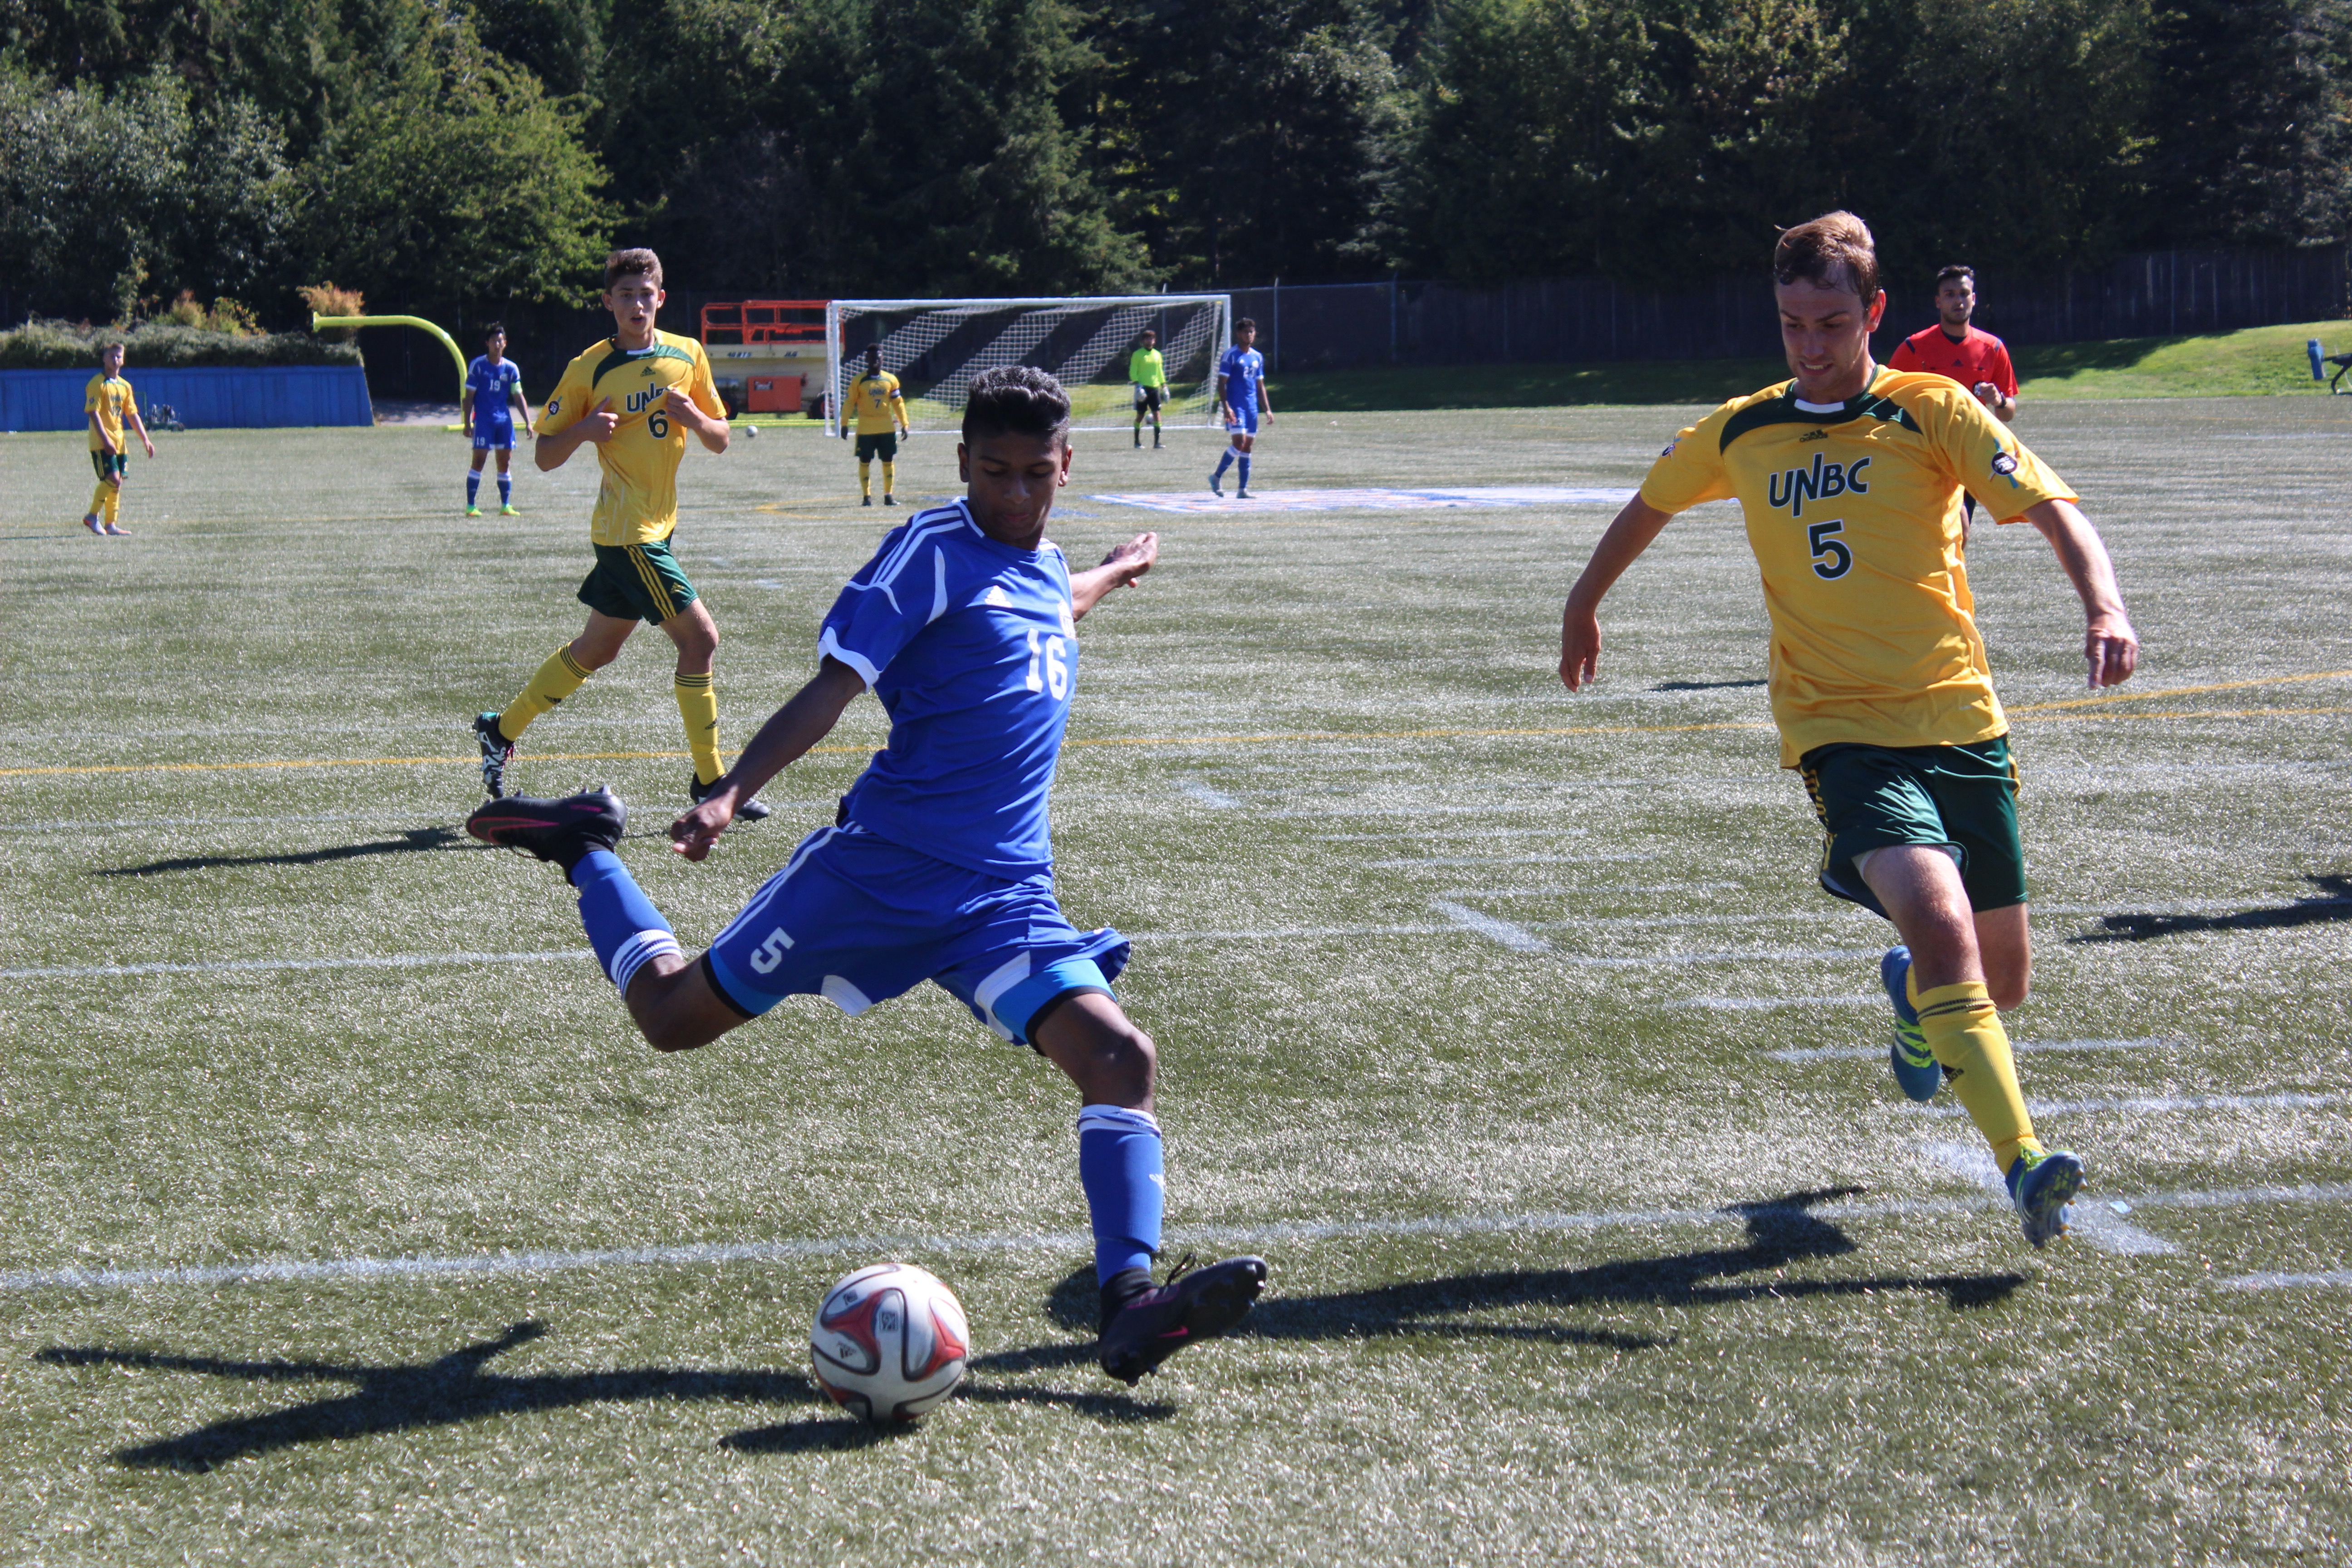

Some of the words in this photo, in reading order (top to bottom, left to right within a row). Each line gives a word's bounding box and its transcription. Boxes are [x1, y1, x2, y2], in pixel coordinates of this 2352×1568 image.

[489, 379, 500, 392] 19
[626, 382, 665, 412] UN
[874, 398, 881, 408] 7
[647, 409, 669, 439] 6
[1998, 460, 2015, 472] 25
[1769, 453, 1872, 518] UNBC
[1807, 519, 1852, 580] 5
[1025, 627, 1068, 701] 16
[750, 926, 795, 974] 5
